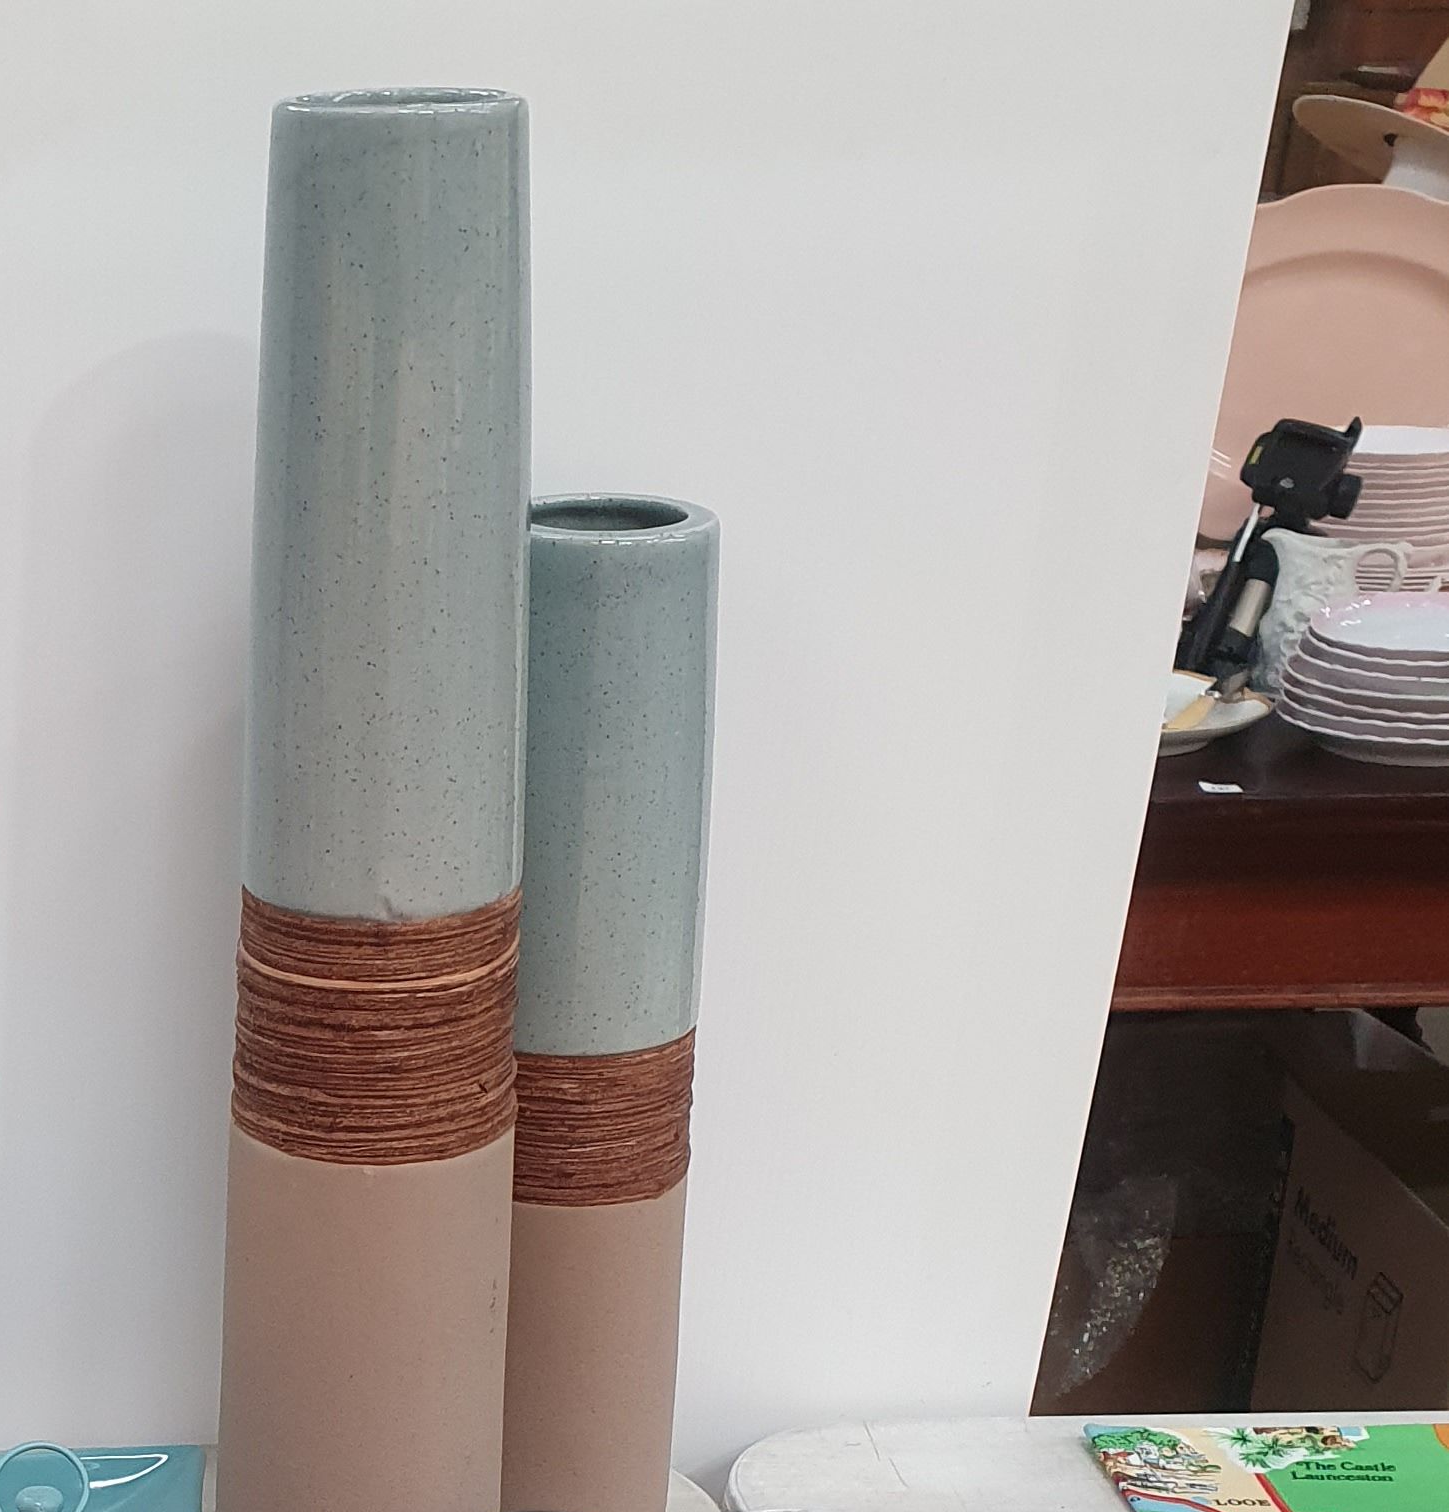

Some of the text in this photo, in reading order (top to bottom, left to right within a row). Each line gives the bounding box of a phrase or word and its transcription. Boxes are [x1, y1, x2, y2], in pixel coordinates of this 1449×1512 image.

[1296, 1461, 1396, 1473] The Castle
[1291, 1471, 1394, 1482] Launceston
[1214, 1499, 1271, 1507] LOOE
